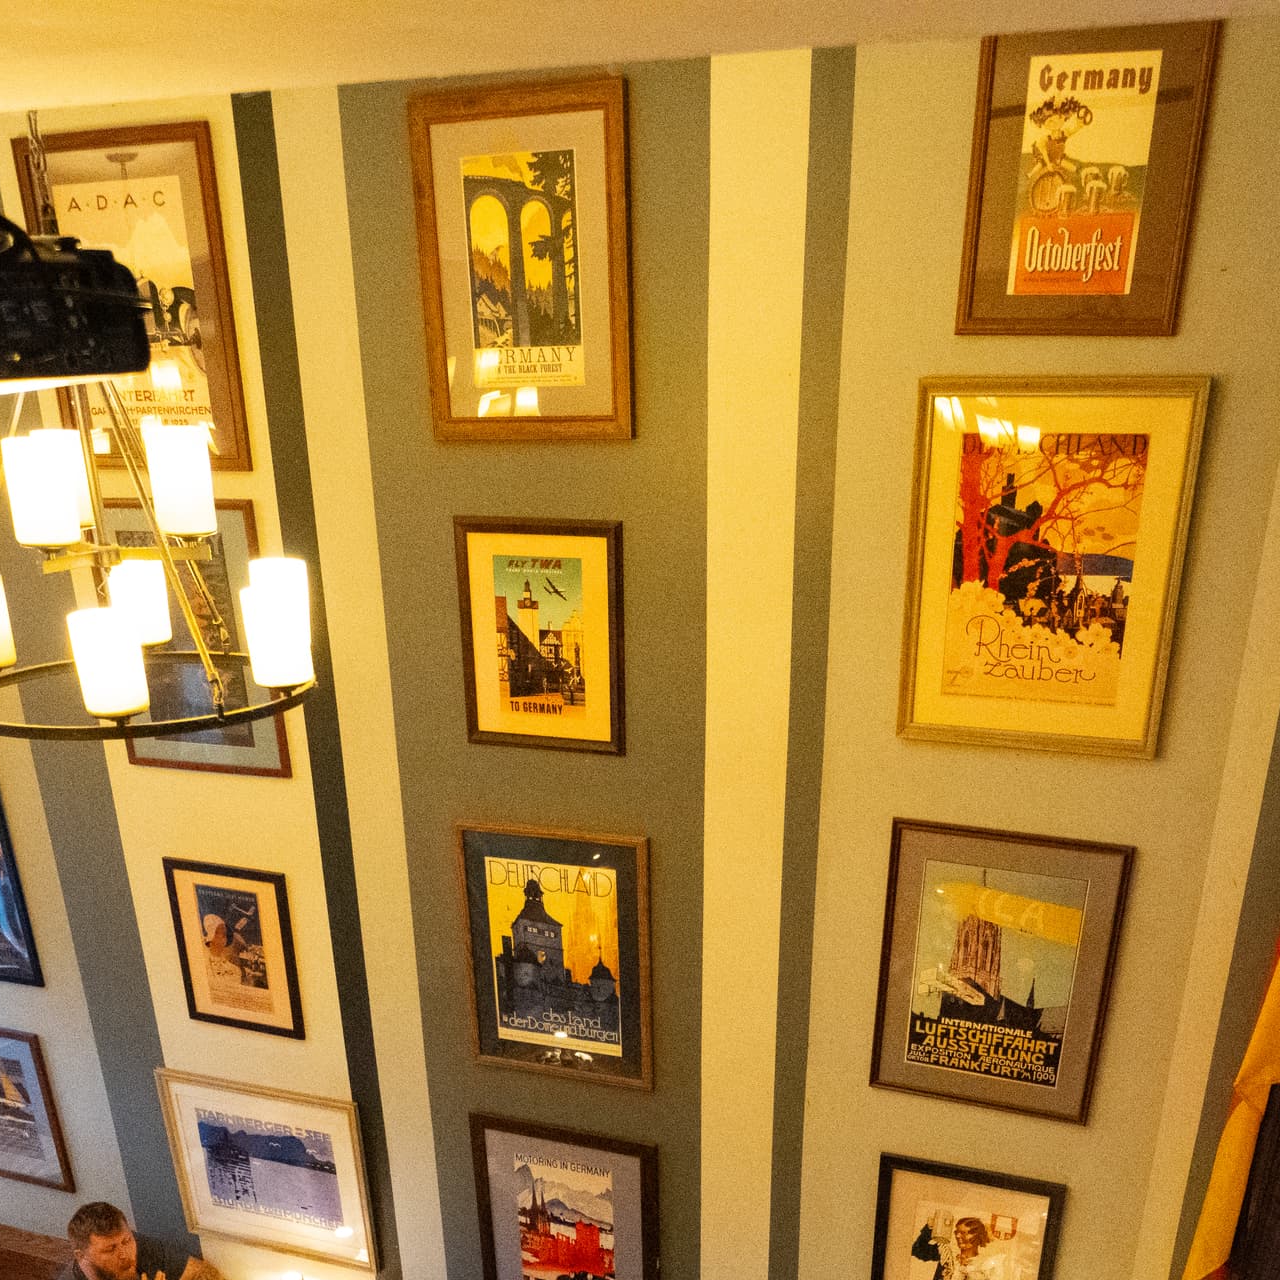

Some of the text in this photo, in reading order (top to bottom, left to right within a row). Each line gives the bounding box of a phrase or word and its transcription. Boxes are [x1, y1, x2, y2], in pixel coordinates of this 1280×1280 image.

[1038, 62, 1155, 95] Germany
[1024, 225, 1123, 283] Octoberfest
[494, 346, 577, 365] ERMANY
[530, 558, 562, 570] TWA
[965, 614, 1062, 664] Rhein
[509, 700, 564, 715] TO GERMANY
[914, 1019, 1058, 1055] LUFTSCHIFFAHRT
[940, 1017, 1034, 1039] INTERNATIONALE
[910, 1043, 1055, 1074] EXPOSITION AERONAUTIQUE
[923, 1035, 1045, 1066] AUSSTELLUNG
[929, 1053, 1020, 1079] FRANKFURT
[1032, 1071, 1056, 1084] 1909
[514, 1152, 611, 1178] MOTORING IN GERMANY
